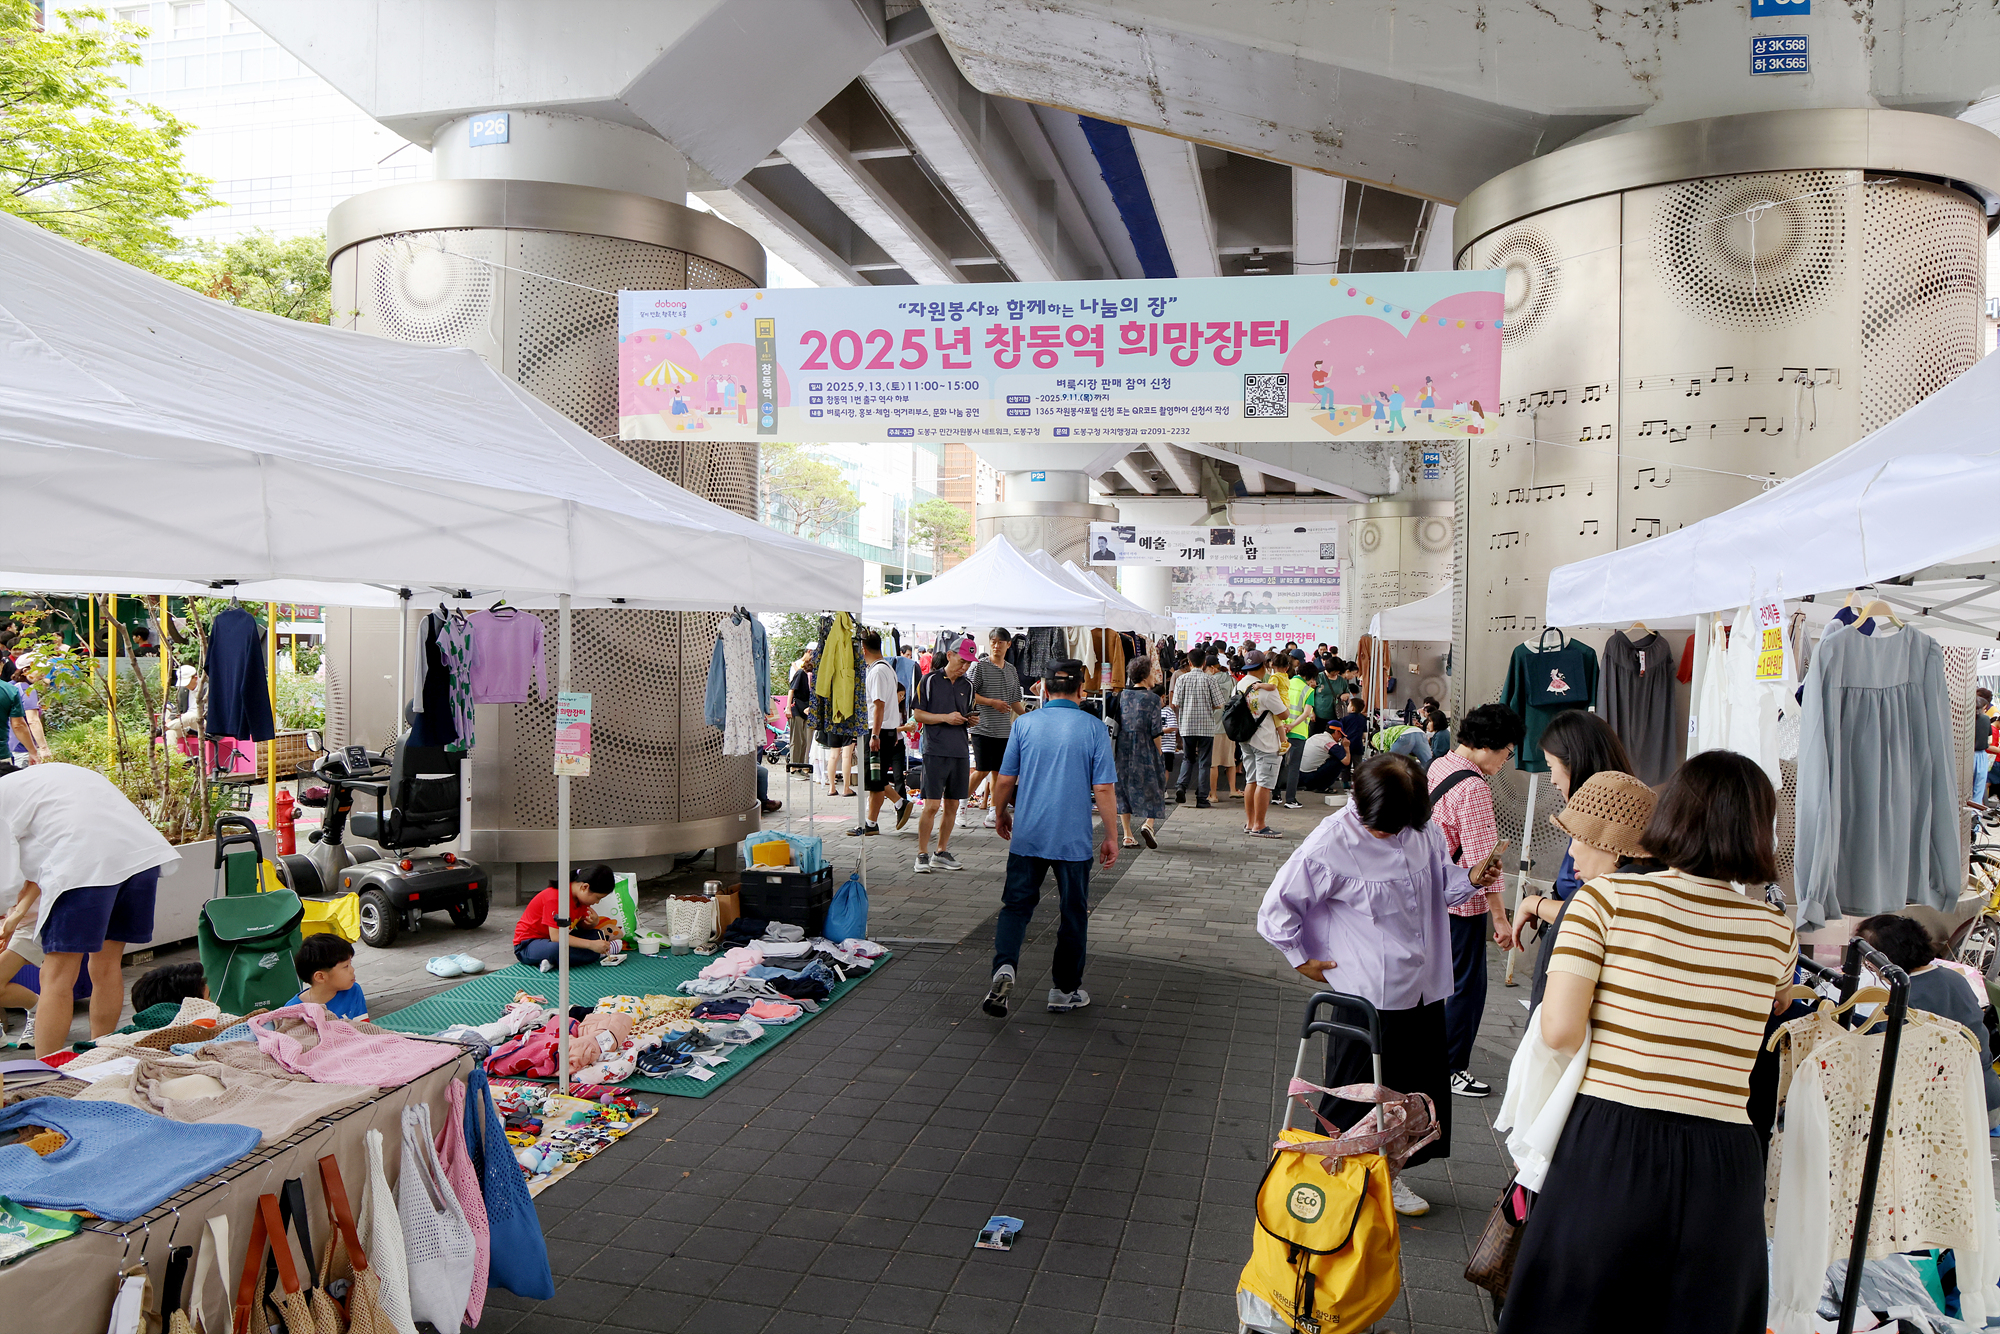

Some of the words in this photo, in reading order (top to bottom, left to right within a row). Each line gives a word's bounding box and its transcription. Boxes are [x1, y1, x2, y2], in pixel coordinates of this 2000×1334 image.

[1754, 41, 1767, 53] 상
[1754, 59, 1767, 71] 하
[473, 118, 506, 138] P26
[655, 299, 687, 310] dobong
[1007, 299, 1074, 319] 함께하는
[1080, 297, 1139, 318] 나눔의
[763, 341, 769, 353] 1
[798, 325, 972, 370] 2025년
[985, 323, 1105, 368] 창동역
[1119, 320, 1289, 368] 희망장터
[762, 363, 772, 399] 창동역
[1056, 378, 1097, 391] 벼룩시장
[1101, 378, 1122, 390] 판매
[1125, 378, 1146, 390] 참여
[1150, 378, 1171, 390] 신청
[827, 395, 848, 405] 창동역
[850, 395, 862, 405] 1번
[863, 395, 877, 405] 출구
[879, 395, 893, 404] 역사
[895, 394, 909, 402] 하부
[827, 408, 857, 418] 벼룩시장,
[933, 408, 947, 417] 문화
[949, 408, 963, 417] 나눔
[965, 408, 980, 417] 공연
[1035, 407, 1054, 416] 1365
[1056, 407, 1098, 416] 자원봉사포털
[1100, 407, 1114, 416] 신청
[1116, 407, 1130, 415] 또는
[1132, 406, 1157, 415] QR코드
[1159, 406, 1188, 415] 촬영하여
[1191, 406, 1213, 415] 신청서
[1215, 406, 1230, 415] 작성
[917, 428, 937, 436] 도봉구
[939, 428, 980, 436] 민간자원봉사
[1013, 427, 1041, 436] 도봉구청
[1073, 427, 1100, 436] 도봉구청
[1103, 427, 1138, 436] 자치행정과
[1139, 536, 1167, 550] 예술
[1180, 547, 1205, 560] 기계
[1759, 604, 1779, 626] 전제품
[1242, 631, 1272, 644] 창동역
[1274, 632, 1316, 645] 희망장터
[560, 708, 586, 717] 희망장터
[1315, 1309, 1340, 1324] 할인점
